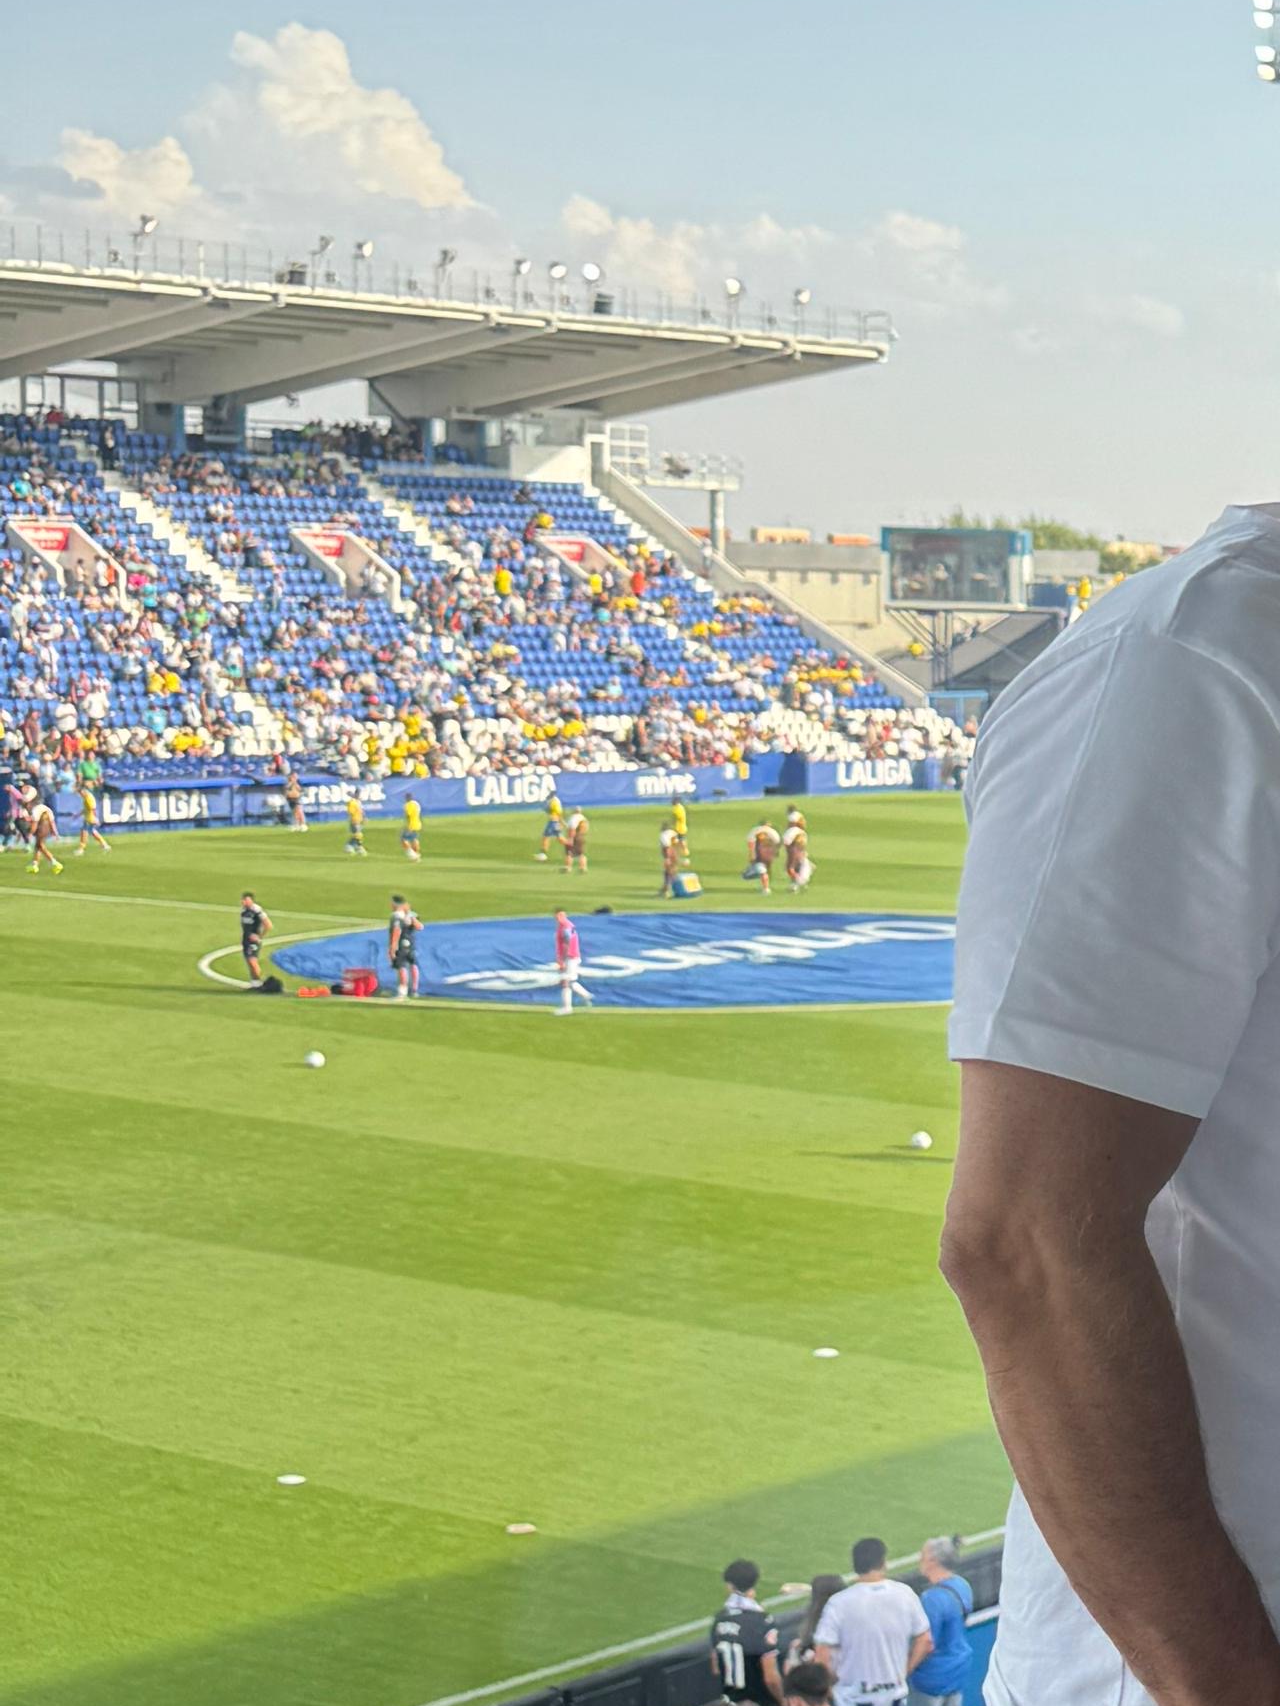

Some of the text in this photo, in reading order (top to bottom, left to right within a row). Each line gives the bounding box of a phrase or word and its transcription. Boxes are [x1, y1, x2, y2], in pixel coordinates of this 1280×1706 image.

[837, 758, 913, 787] LALIGA
[466, 774, 557, 805] LALIGA
[102, 790, 209, 823] LALIGA
